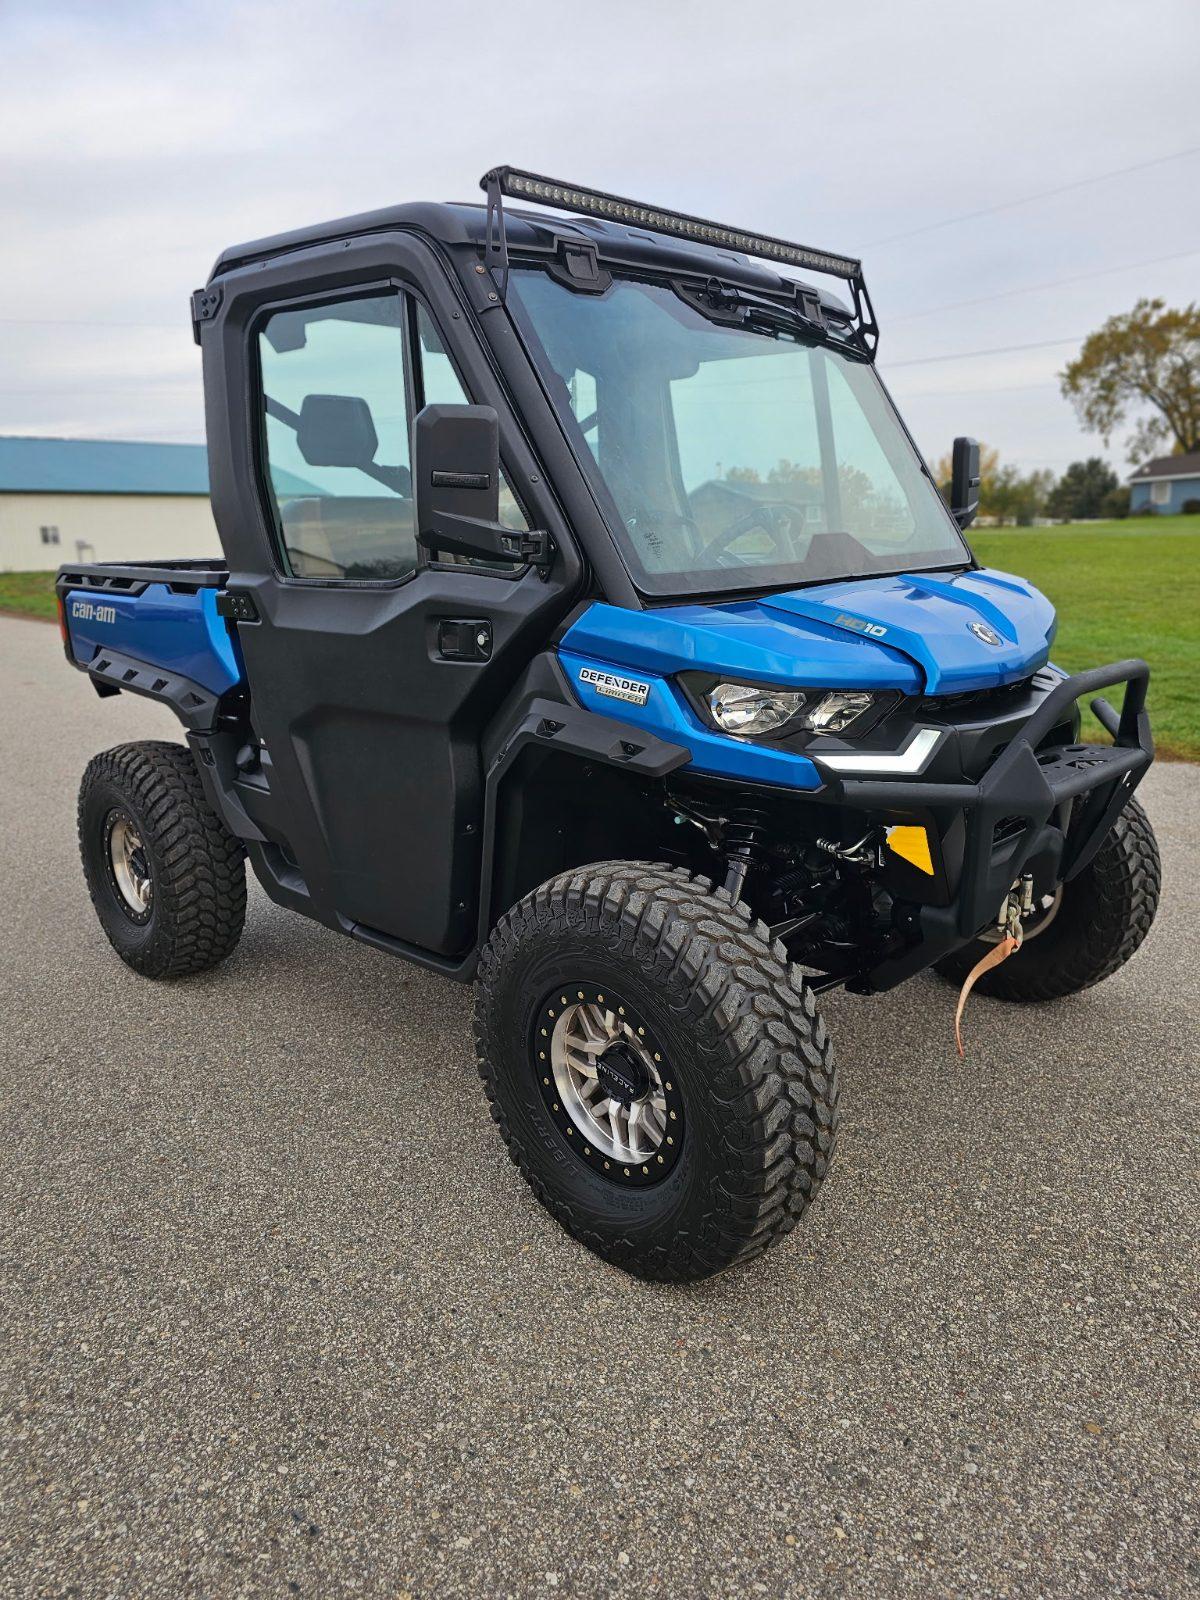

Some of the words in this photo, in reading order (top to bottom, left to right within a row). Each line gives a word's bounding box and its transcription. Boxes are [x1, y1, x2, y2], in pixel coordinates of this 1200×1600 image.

[72, 601, 116, 624] can-am
[581, 669, 647, 694] DEFENDER
[597, 1062, 635, 1094] RACELINE
